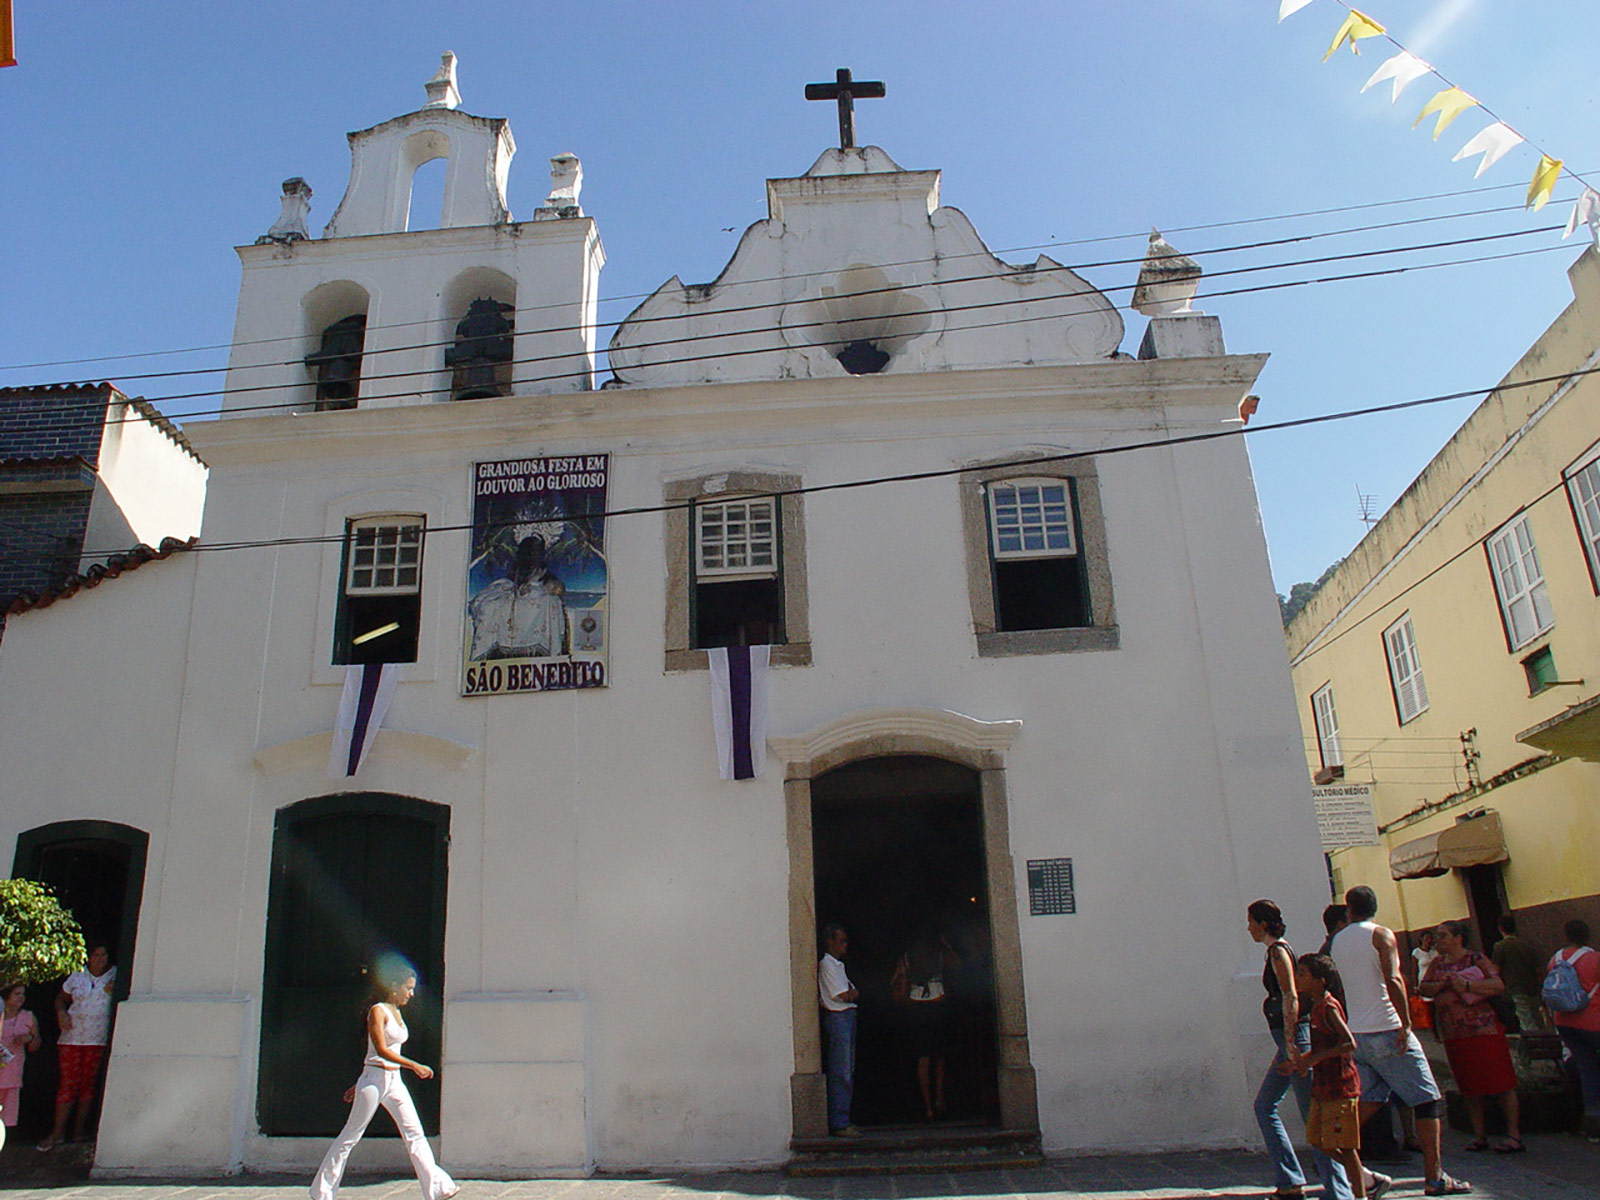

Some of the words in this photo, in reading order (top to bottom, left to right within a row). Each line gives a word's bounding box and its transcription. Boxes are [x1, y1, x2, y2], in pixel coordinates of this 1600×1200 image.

[479, 459, 546, 478] GRANDIOSA
[548, 457, 584, 473] FESTA
[586, 456, 605, 471] EM
[476, 477, 525, 496] LOUVOR
[527, 476, 545, 492] AO
[546, 472, 605, 490] GLORIOSO
[465, 662, 503, 694] SÃO
[506, 660, 605, 691] BENEDITO
